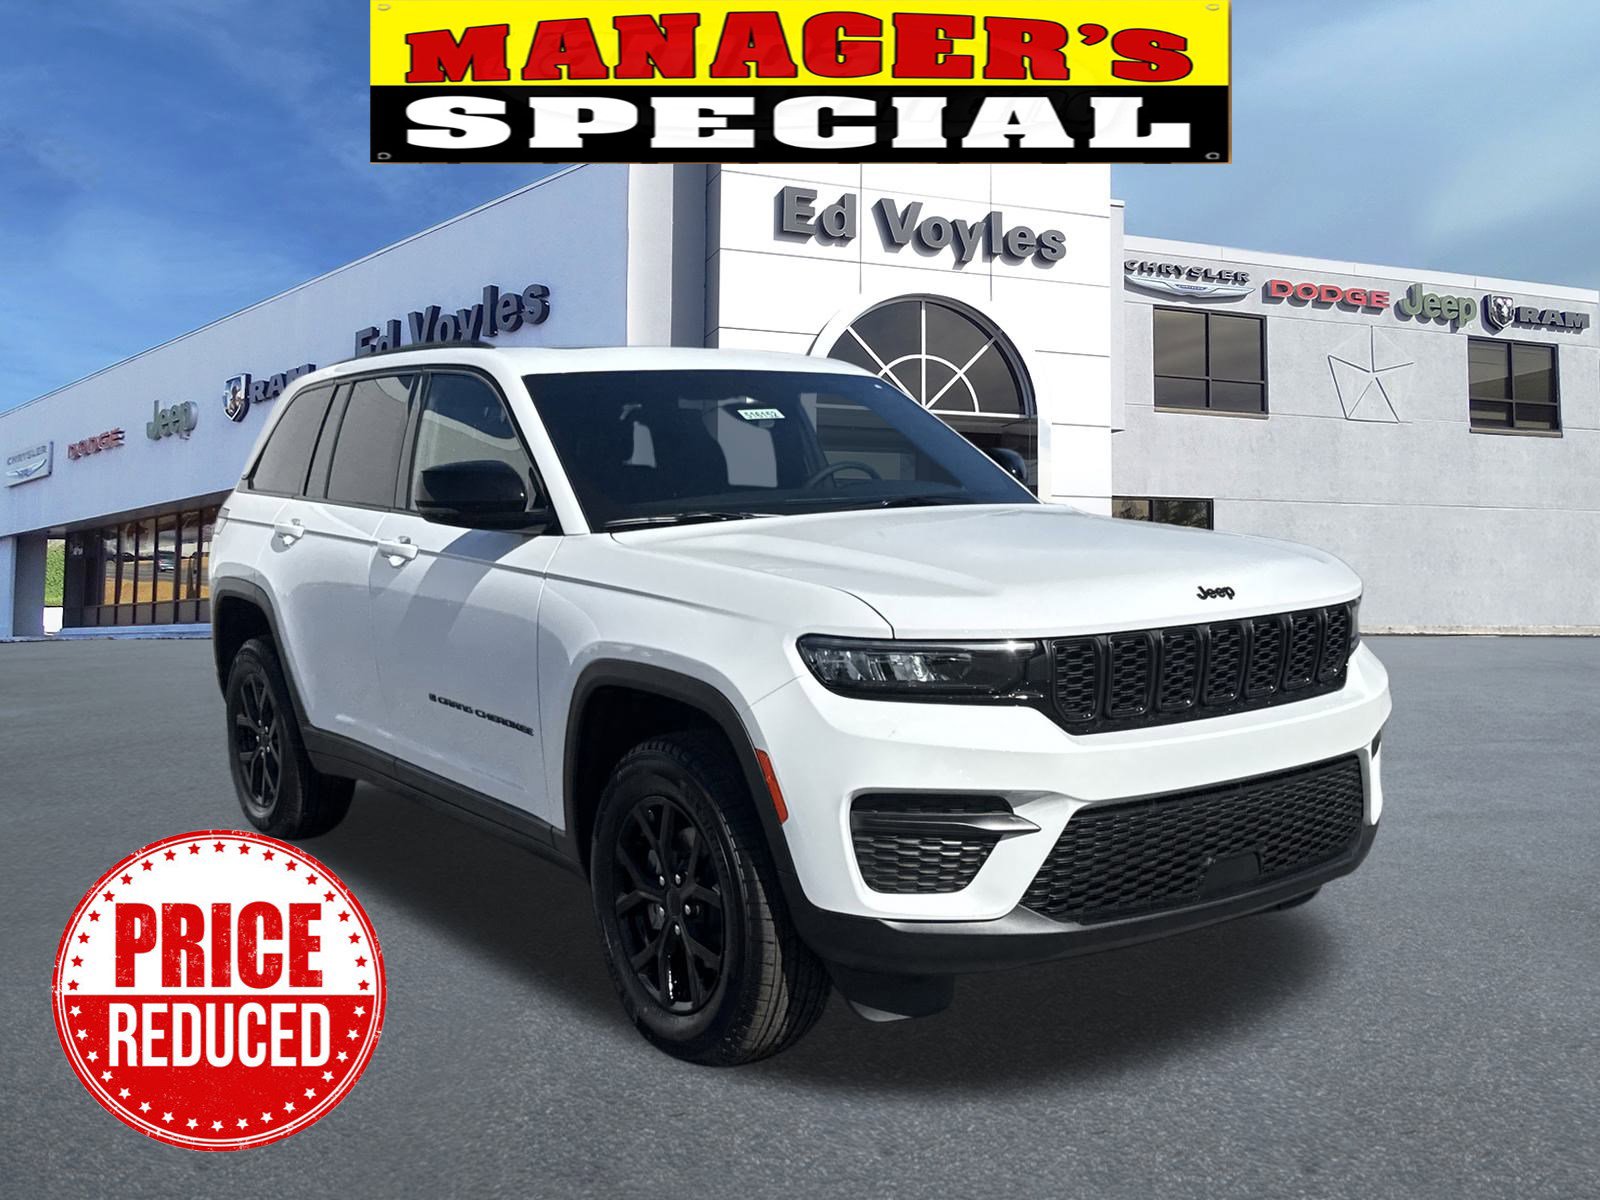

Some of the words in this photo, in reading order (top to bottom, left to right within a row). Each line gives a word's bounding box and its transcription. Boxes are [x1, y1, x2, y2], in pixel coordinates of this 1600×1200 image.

[774, 186, 857, 244] Ed
[871, 198, 1067, 269] Voyles
[1124, 260, 1251, 285] CHRYSLER
[1264, 279, 1390, 311] DODGE
[1395, 283, 1478, 331] Jeep
[408, 284, 550, 346] Voyles
[1516, 306, 1590, 332] RAM
[147, 400, 199, 440] Jeep
[68, 428, 126, 460] DODGE
[1196, 586, 1236, 600] Jeep
[475, 709, 534, 737] CHEROKEE
